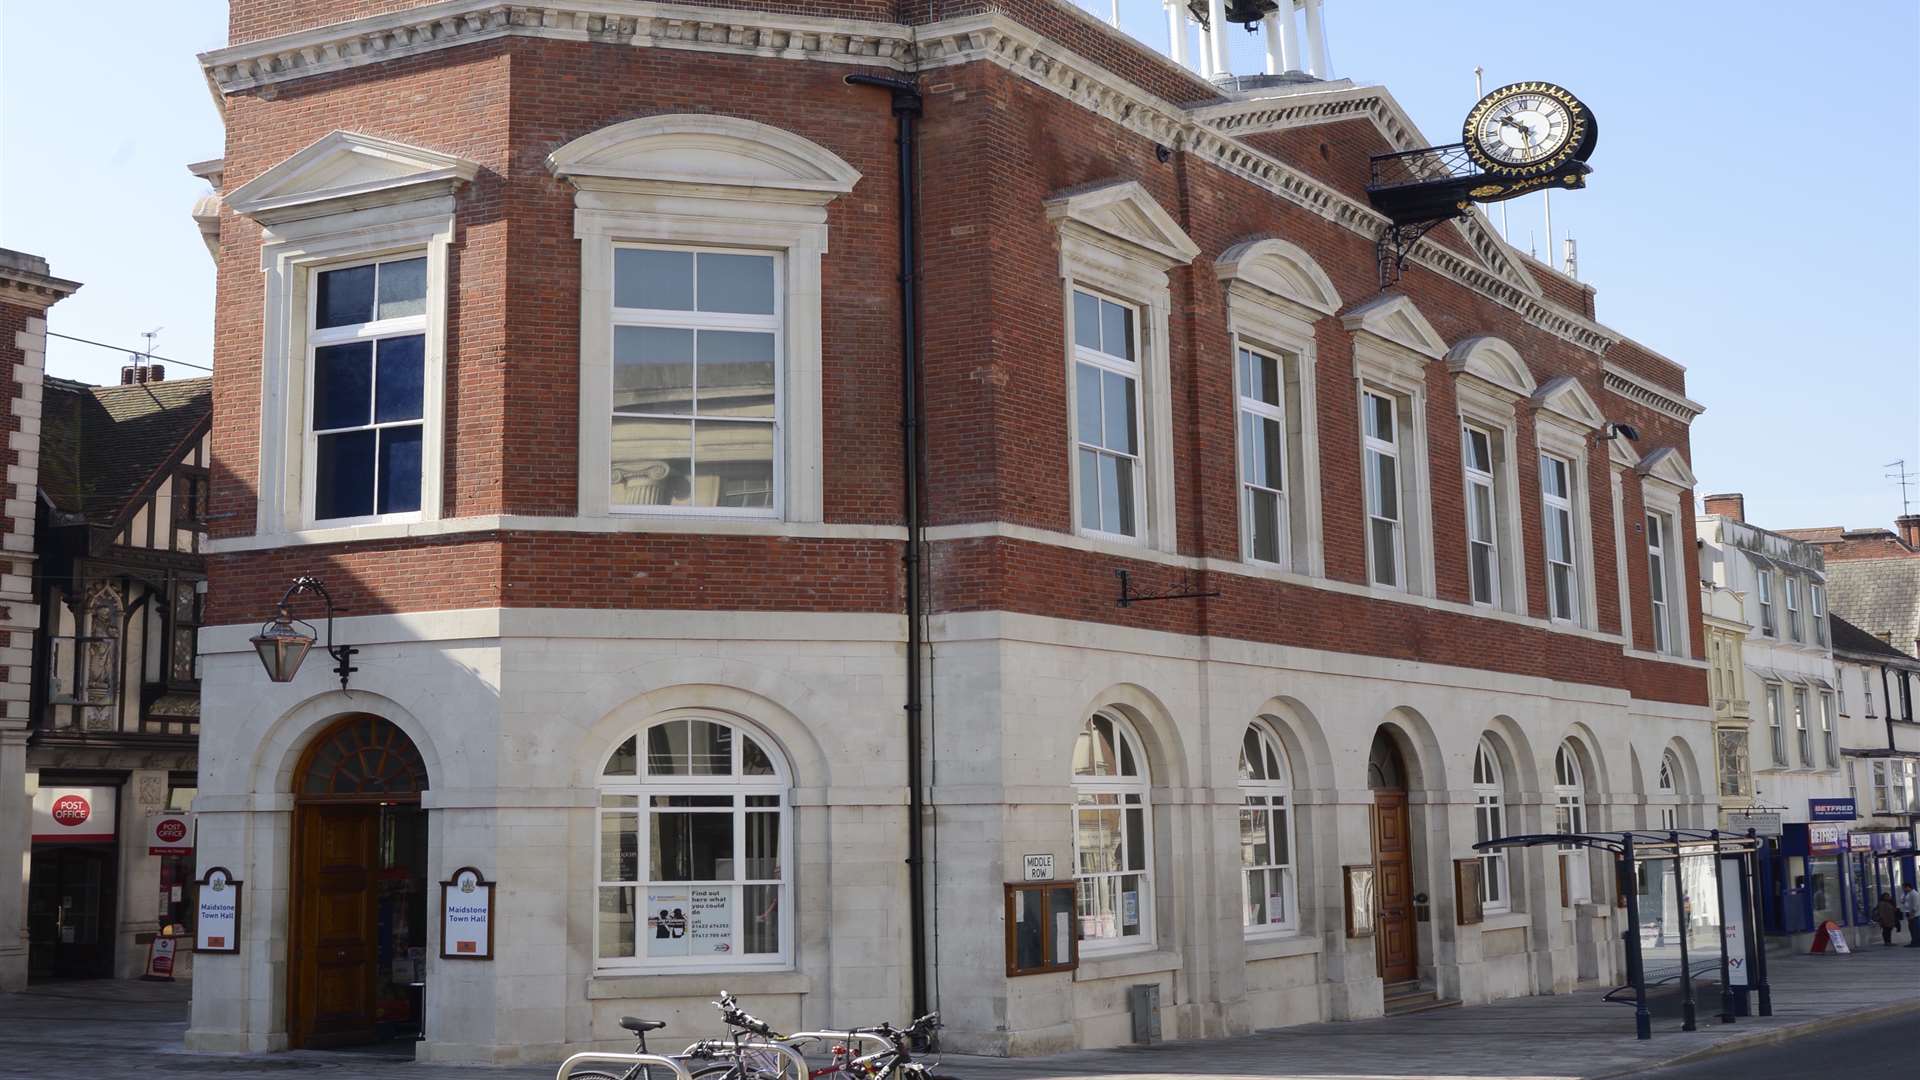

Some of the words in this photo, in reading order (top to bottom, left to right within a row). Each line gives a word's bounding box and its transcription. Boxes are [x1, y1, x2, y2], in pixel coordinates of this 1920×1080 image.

[61, 801, 84, 810] POST
[56, 810, 86, 819] OFFICE
[1027, 857, 1051, 867] MIDDLE
[1031, 868, 1047, 878] ROW
[448, 906, 487, 914] Maidstone
